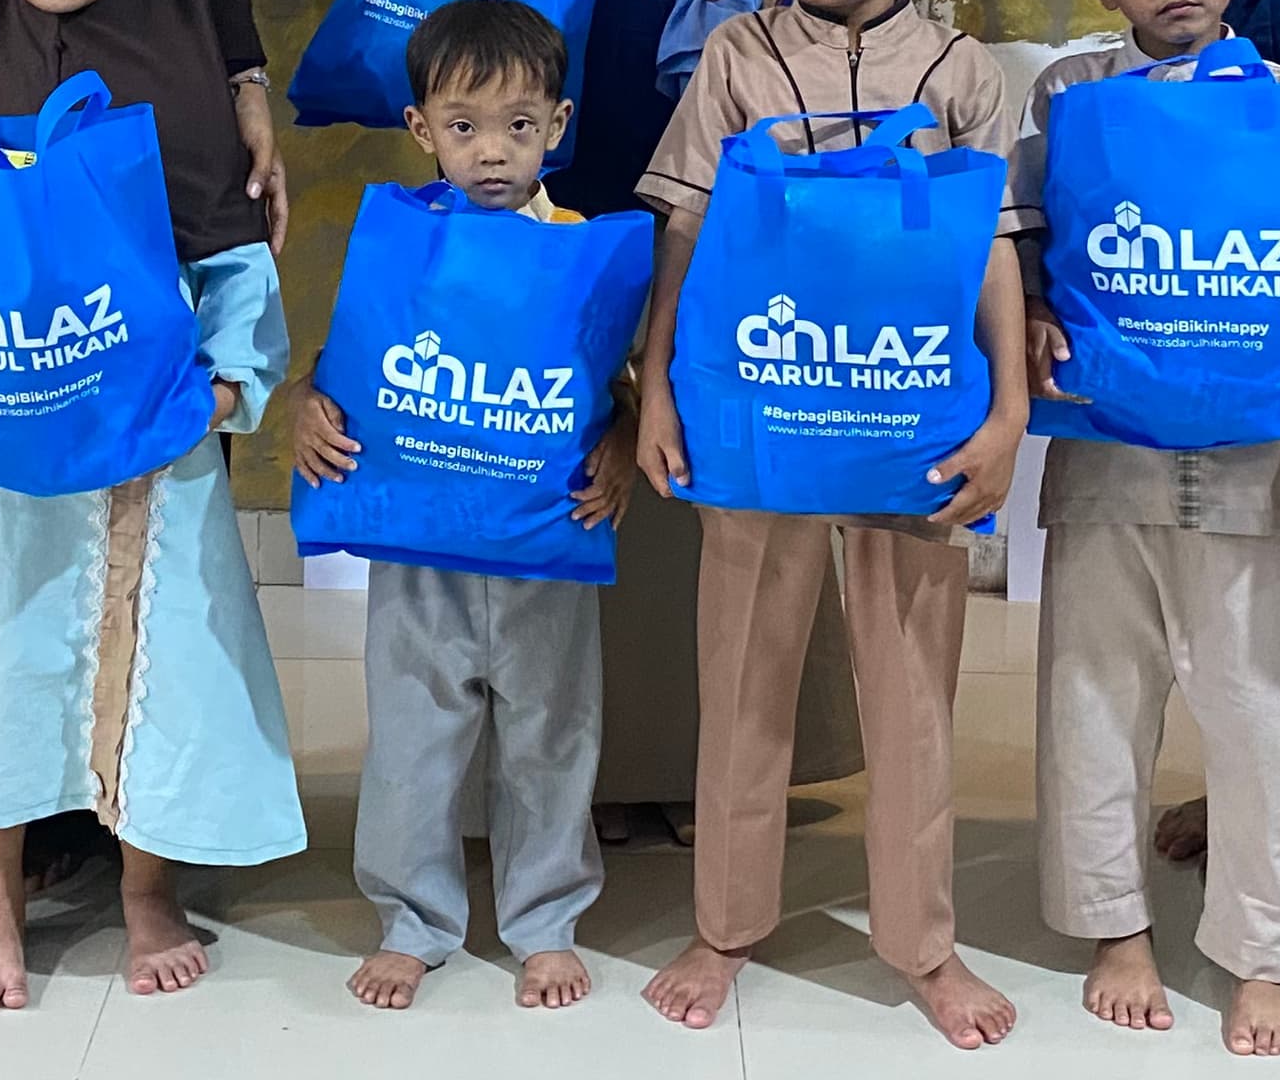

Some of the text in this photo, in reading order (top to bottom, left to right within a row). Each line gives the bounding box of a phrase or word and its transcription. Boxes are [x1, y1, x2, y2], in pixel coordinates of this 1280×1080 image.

[1091, 271, 1189, 297] DARUL
[9, 283, 123, 349] LAZ
[1118, 316, 1269, 336] #BerbagiBikinHappy
[31, 323, 129, 371] HIKAM
[833, 324, 950, 366] LAZ
[470, 362, 574, 409] LAZ
[738, 361, 951, 390] DARUL HIKAM
[377, 387, 574, 434] DARUL HIKAM
[762, 404, 921, 426] #BerbagiBikinHappy
[394, 434, 545, 471] #BerbagiBikinHappy
